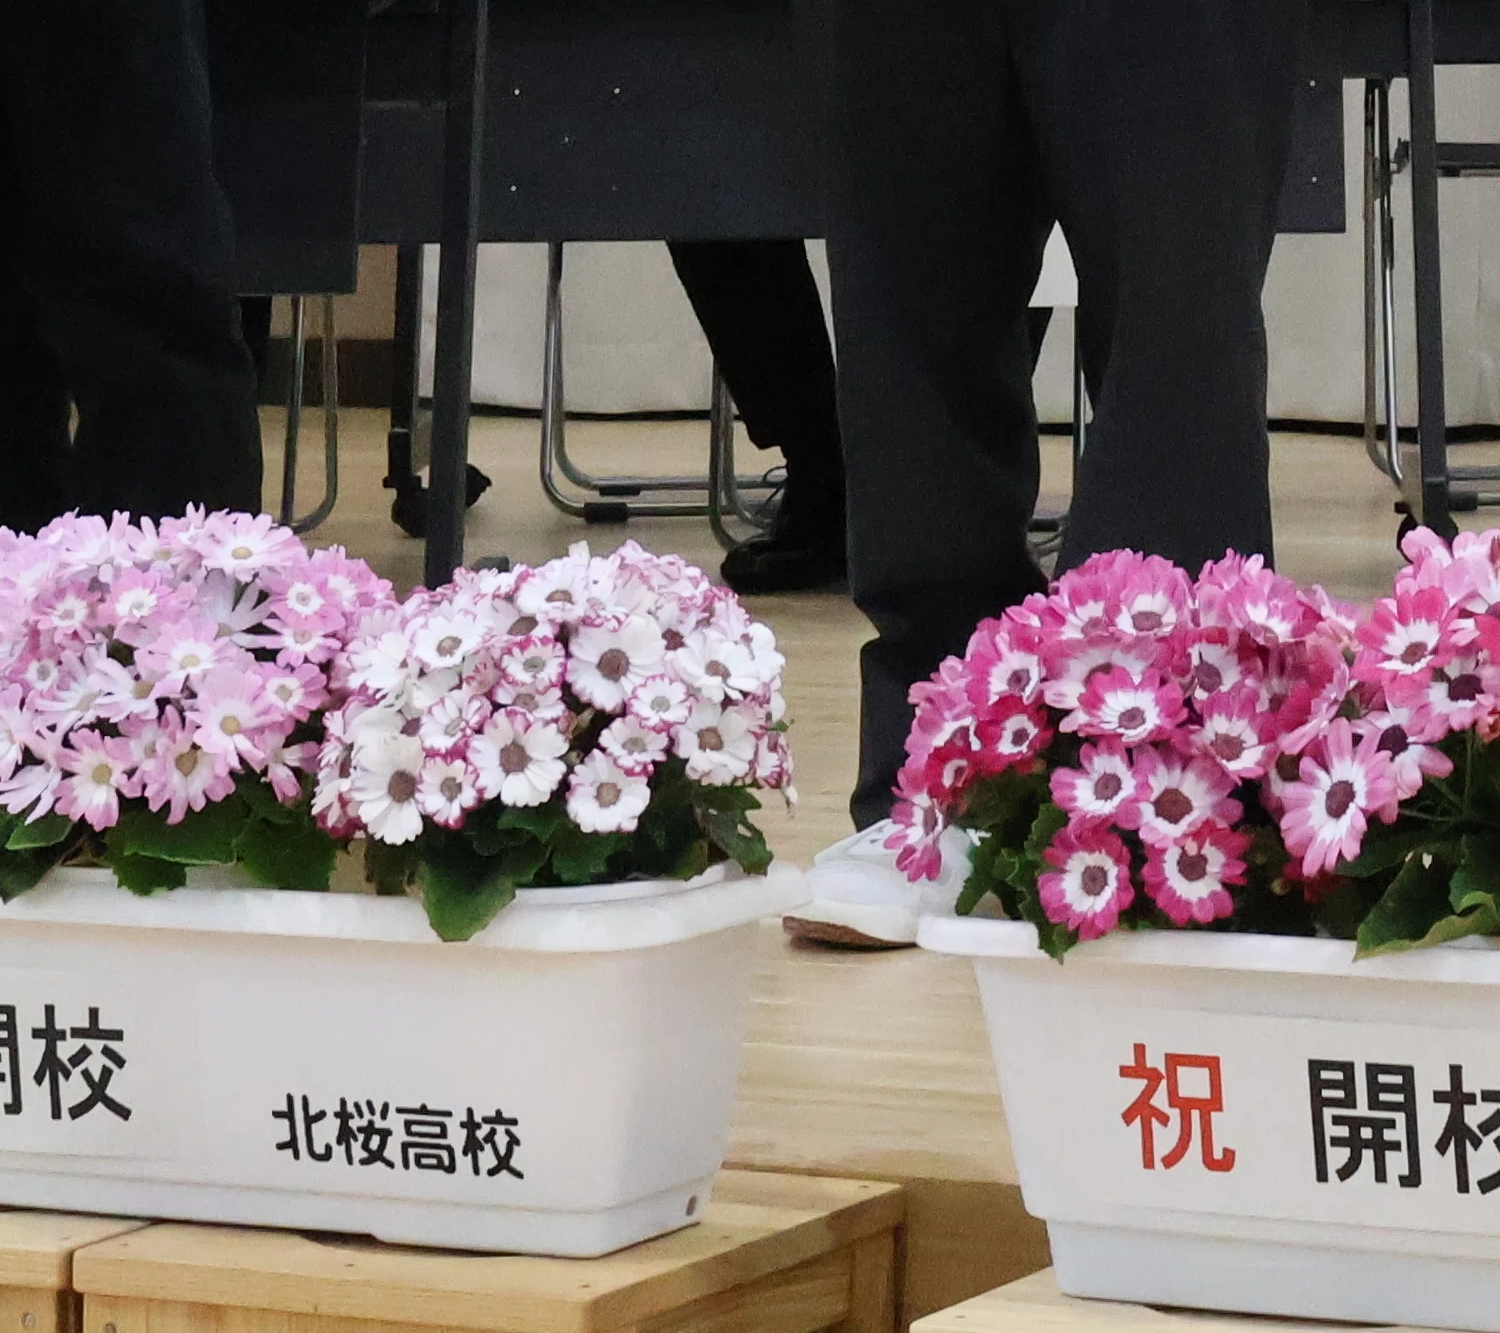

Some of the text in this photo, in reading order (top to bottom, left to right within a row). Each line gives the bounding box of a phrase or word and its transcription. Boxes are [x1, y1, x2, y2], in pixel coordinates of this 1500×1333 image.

[271, 1093, 526, 1180] 北桜高校
[1119, 1042, 1237, 1173] 祝
